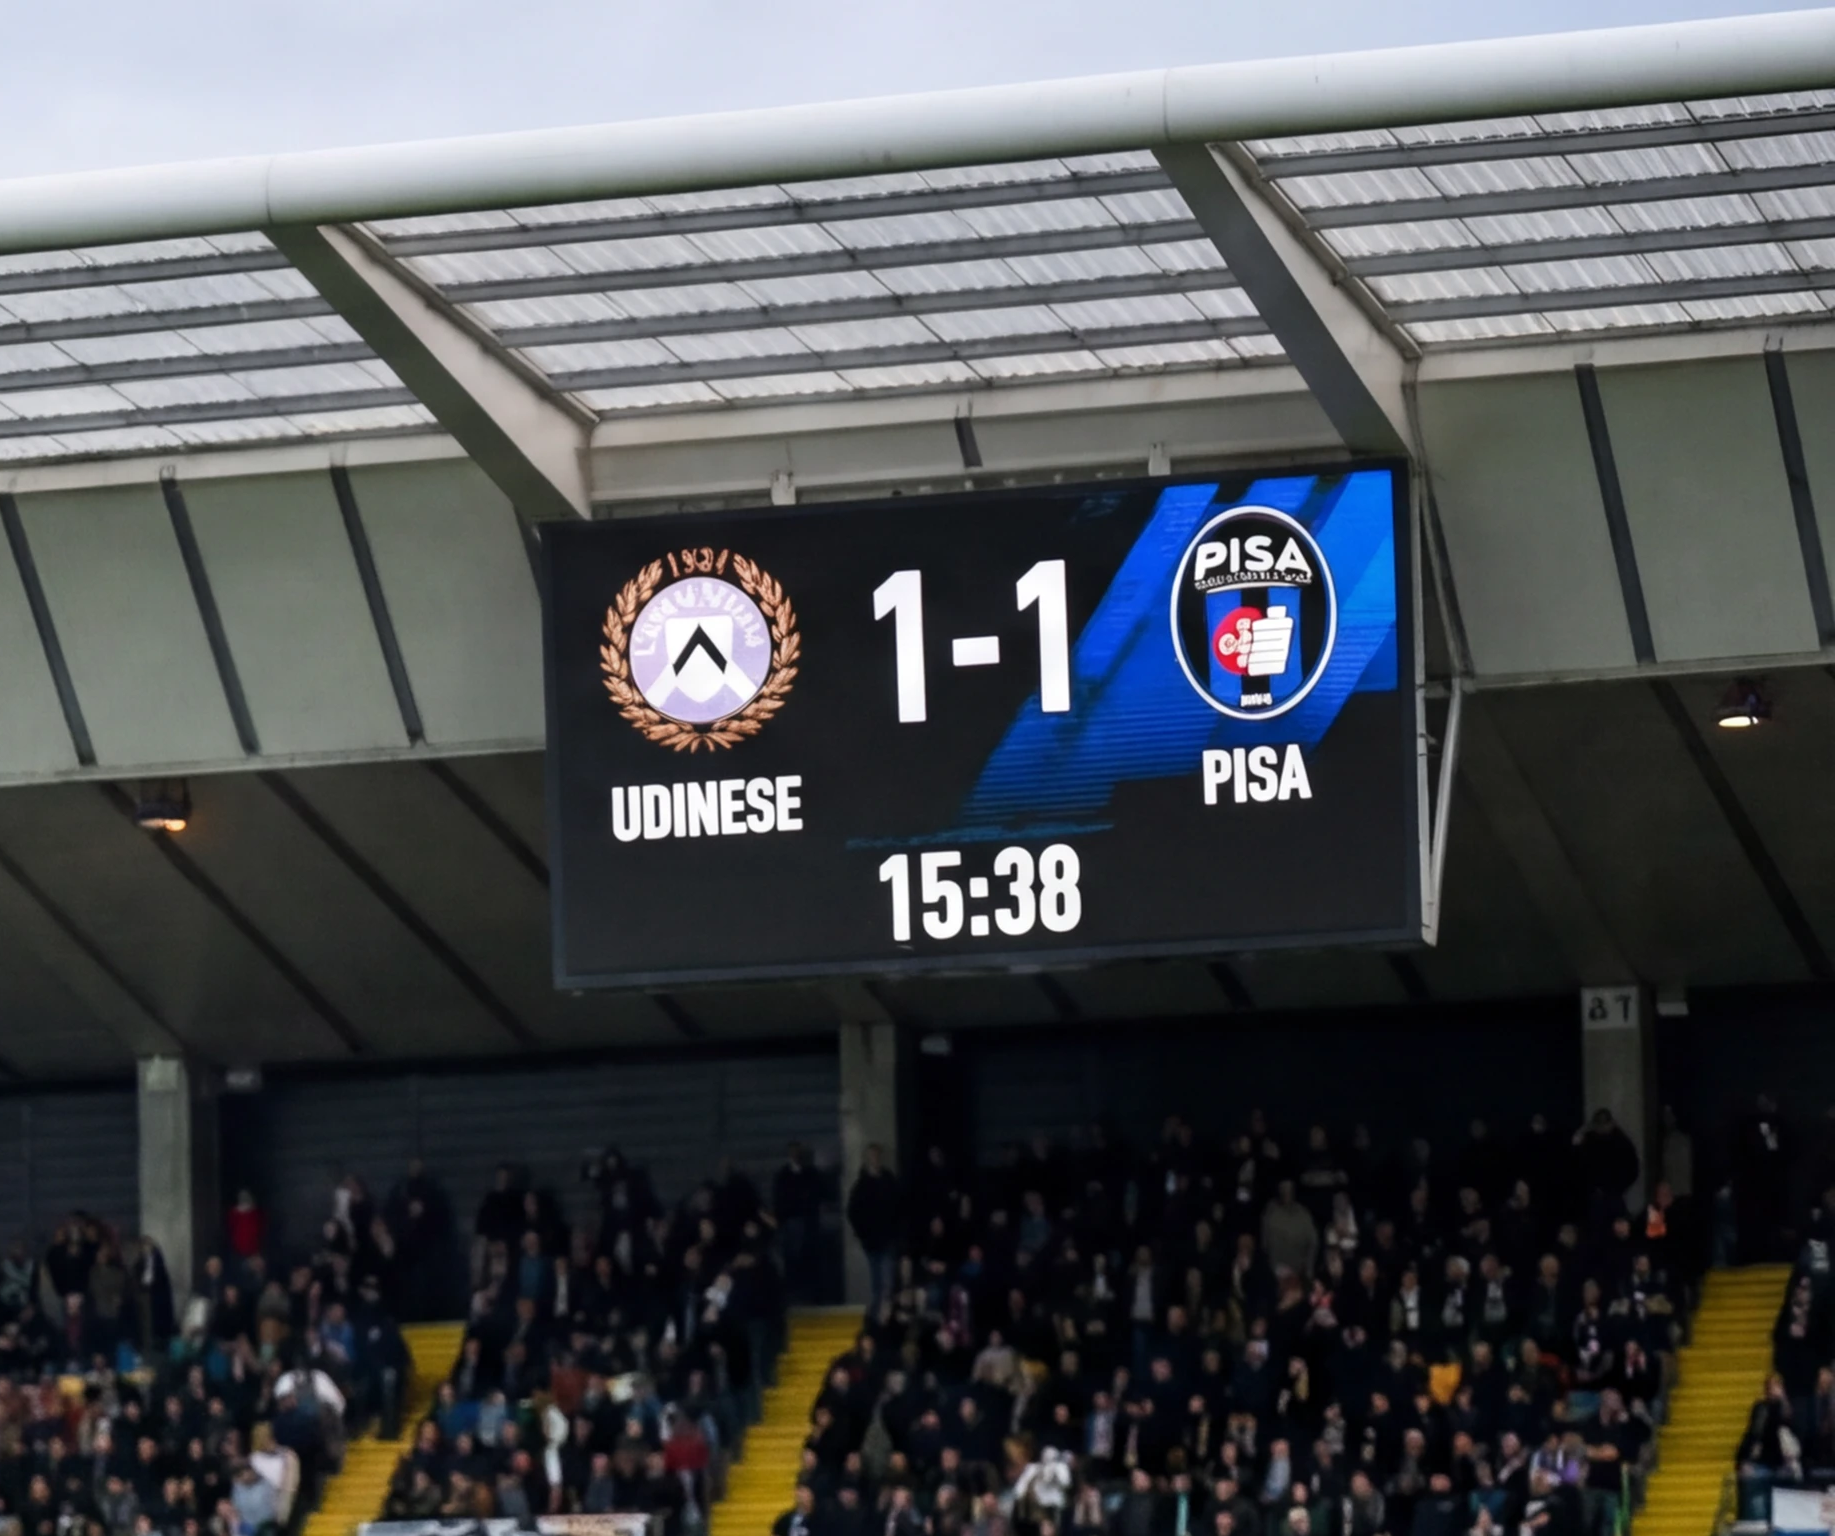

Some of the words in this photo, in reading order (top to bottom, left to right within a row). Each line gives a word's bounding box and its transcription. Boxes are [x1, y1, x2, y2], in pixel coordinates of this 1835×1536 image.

[1194, 535, 1312, 580] PISA
[873, 559, 1070, 723] 1-1
[1202, 744, 1312, 805] PISA
[611, 775, 803, 842] UDINESE
[879, 843, 1082, 941] 15:38
